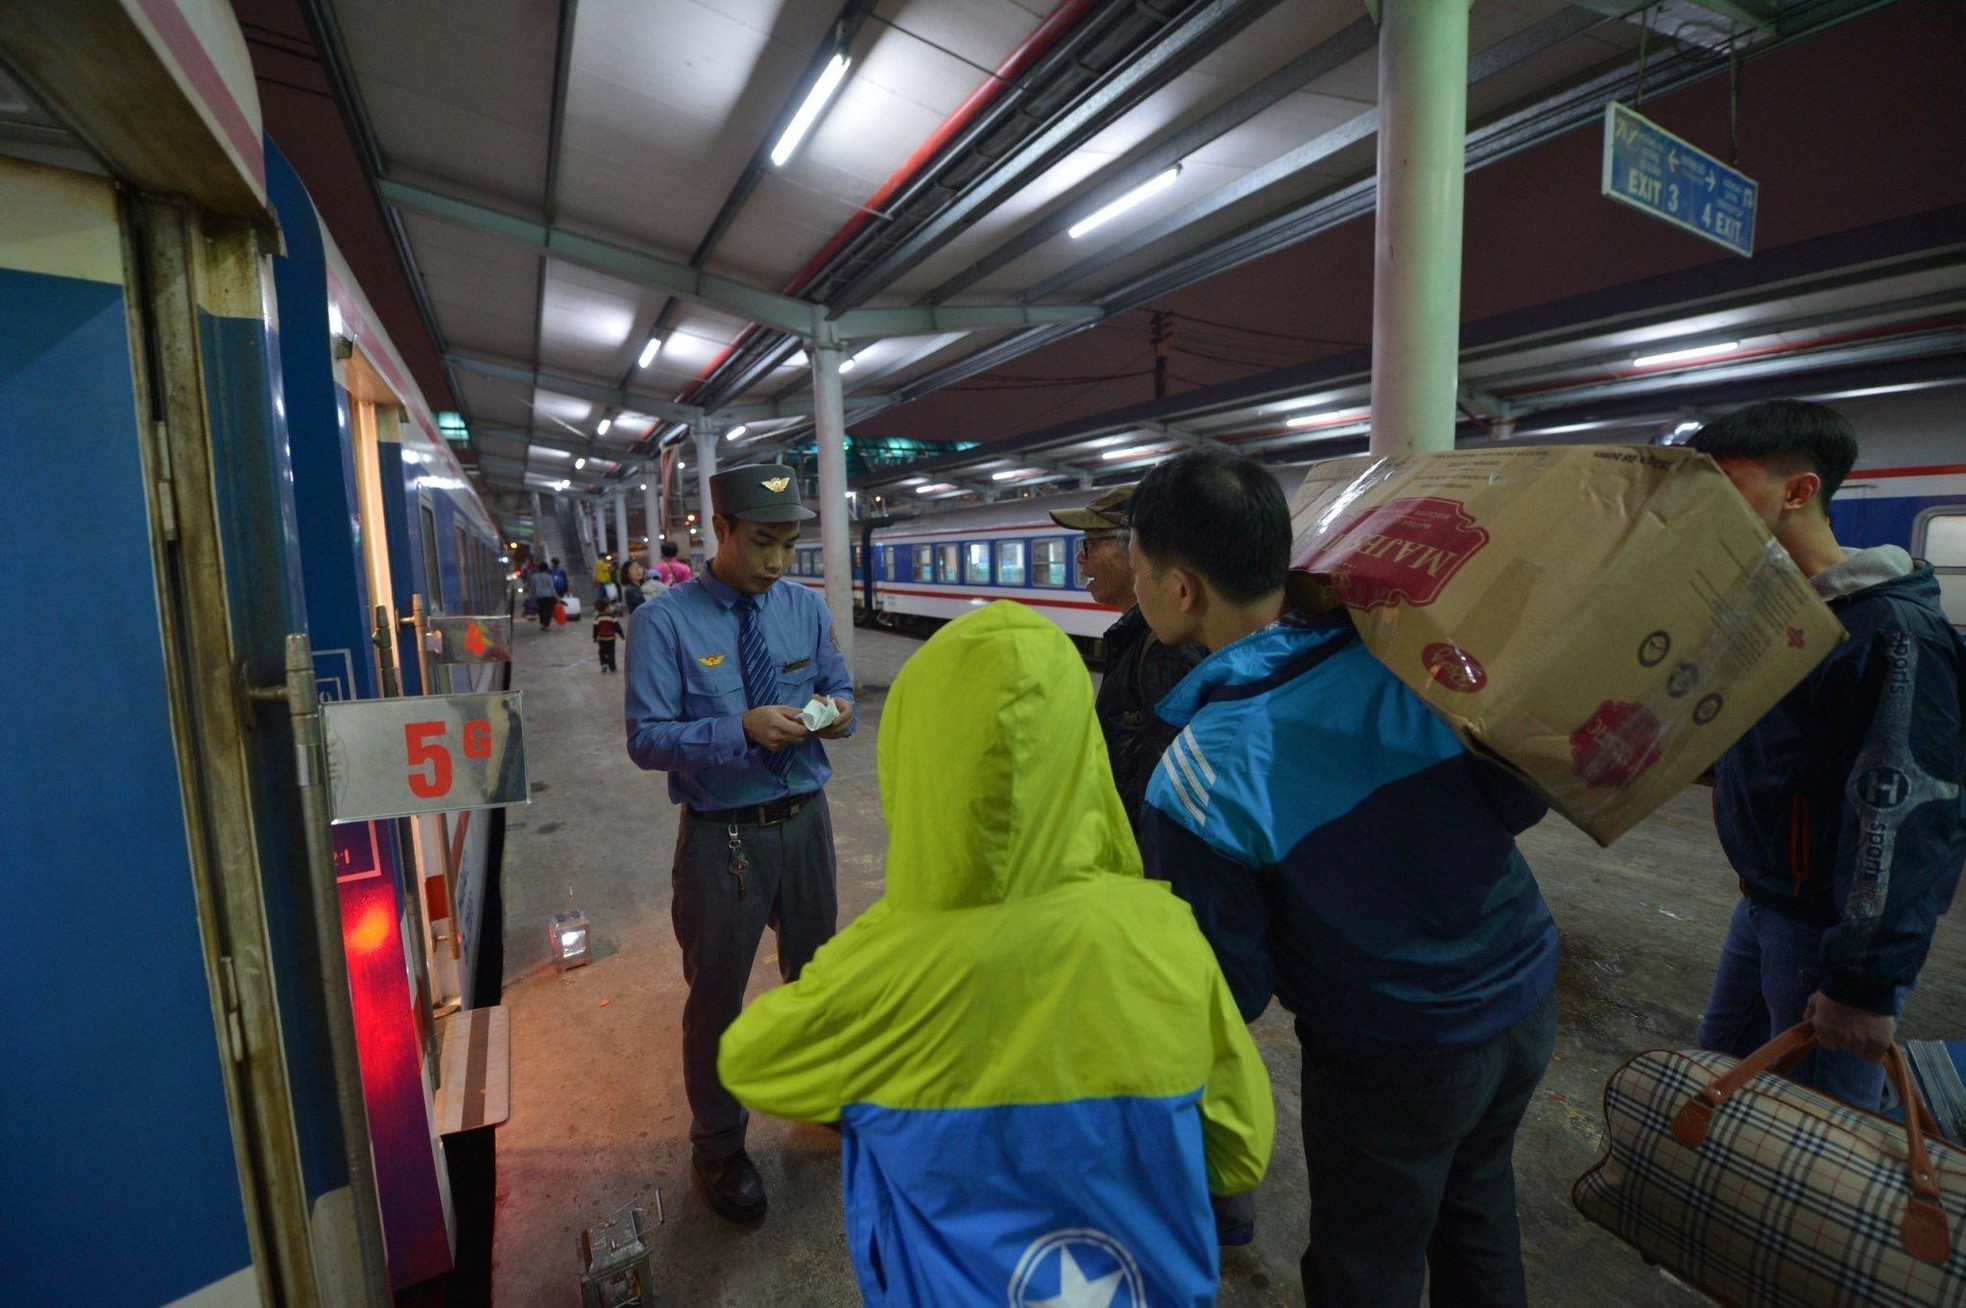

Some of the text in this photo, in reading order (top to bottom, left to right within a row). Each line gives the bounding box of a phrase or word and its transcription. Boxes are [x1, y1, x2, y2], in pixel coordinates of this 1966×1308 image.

[1628, 168, 1662, 206] EXIT
[1667, 184, 1680, 213] 3
[1702, 203, 1743, 243] 4 EXIT
